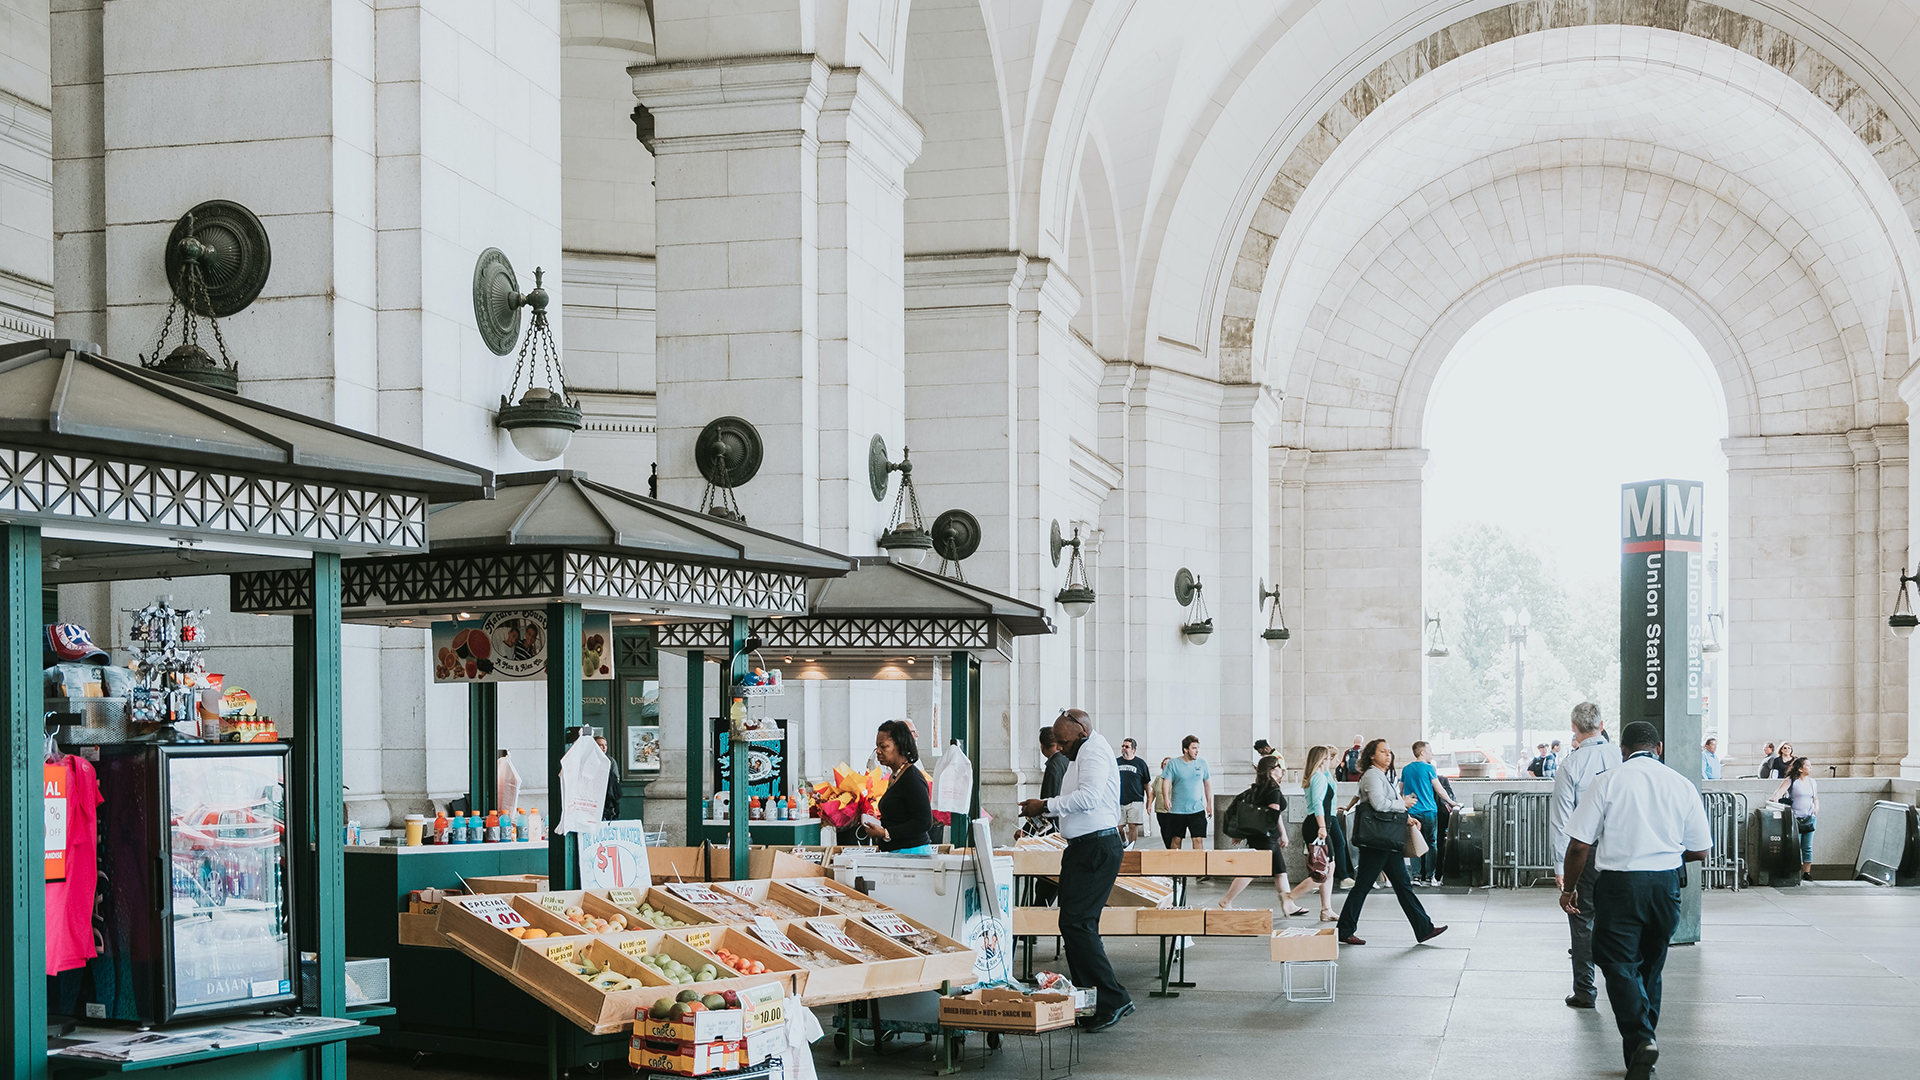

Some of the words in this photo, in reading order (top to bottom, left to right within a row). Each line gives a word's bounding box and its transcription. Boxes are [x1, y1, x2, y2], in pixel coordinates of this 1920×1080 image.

[1623, 485, 1661, 538] M
[1667, 484, 1702, 537] M
[1647, 554, 1662, 617] Union
[1689, 555, 1701, 617] Union
[1646, 623, 1661, 699] Station
[1689, 624, 1701, 699] Station
[49, 828, 62, 837] OFF
[619, 826, 643, 848] WATER
[468, 899, 506, 909] SPECIAL
[883, 924, 914, 934] 1.00
[770, 940, 799, 953] 1.00
[827, 935, 855, 948] 1.00
[207, 977, 254, 995] DASANI
[760, 1006, 782, 1023] 10.00
[960, 1008, 978, 1016] FRUITS
[983, 1009, 997, 1017] NUTS
[1002, 1010, 1020, 1018] SNACK
[652, 1025, 676, 1038] CAPCO
[648, 1057, 673, 1070] CAPCO
